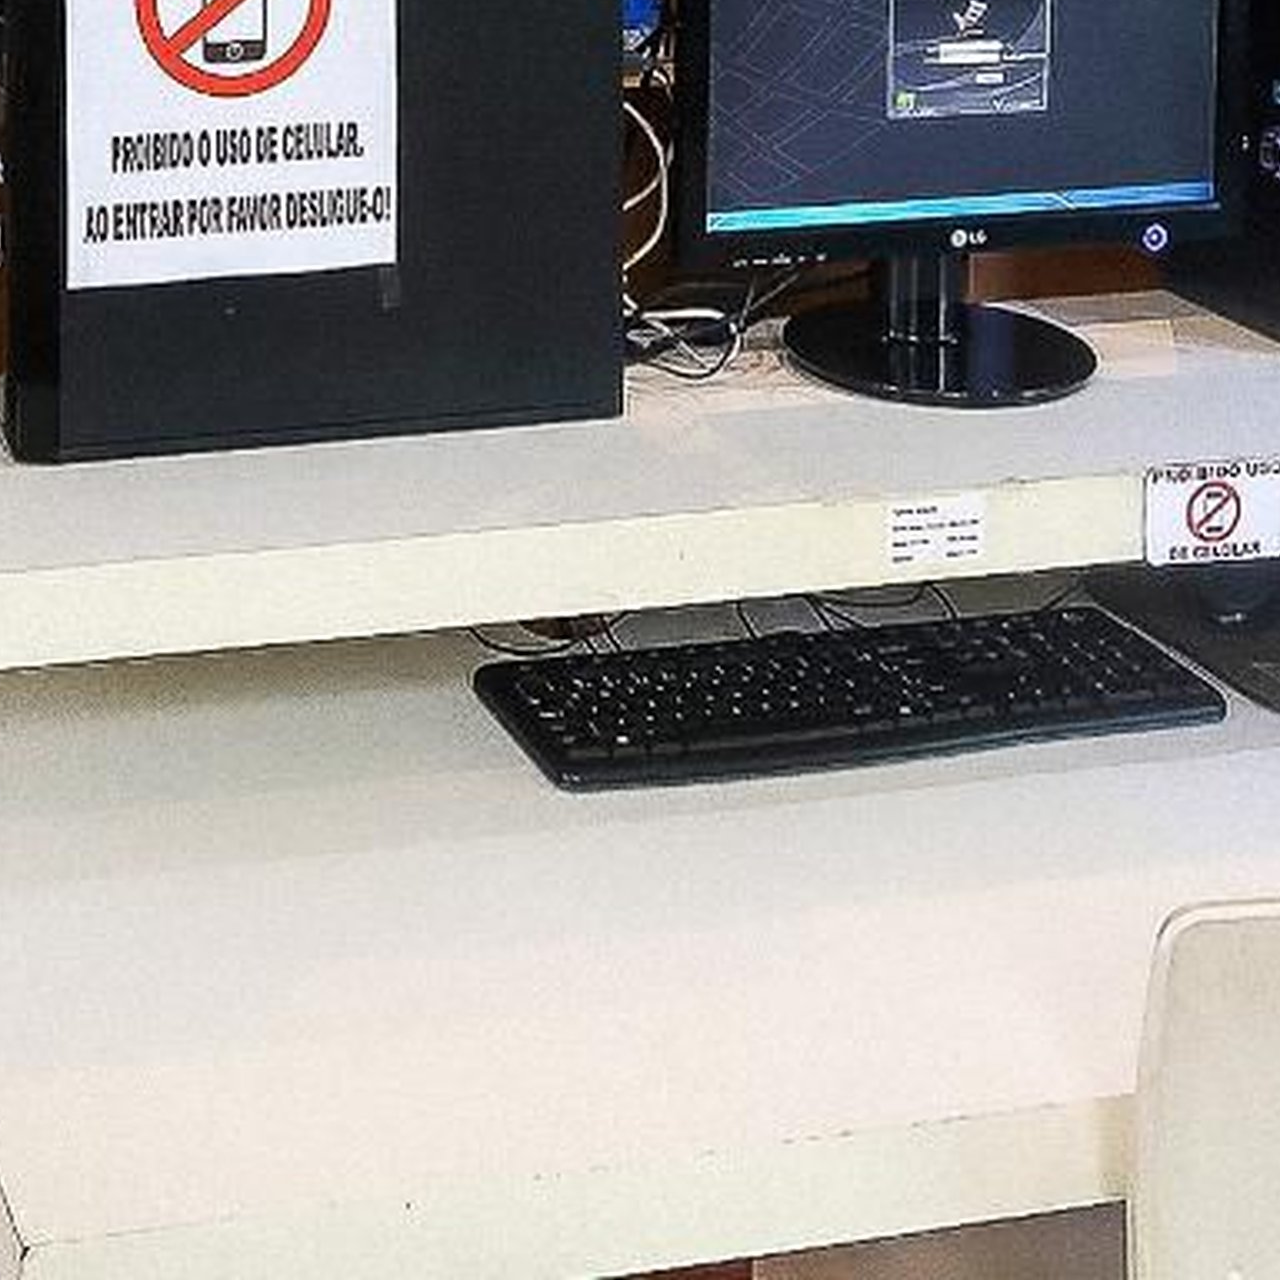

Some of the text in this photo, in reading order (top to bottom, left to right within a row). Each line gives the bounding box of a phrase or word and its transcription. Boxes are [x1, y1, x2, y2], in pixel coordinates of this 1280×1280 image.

[112, 131, 194, 173] PROIBIDO
[198, 129, 211, 168] O
[215, 127, 252, 166] USO
[256, 126, 277, 163] DE
[83, 185, 392, 244] AO ENTRAR POR FAVOR DESLIGUE-O!
[1151, 462, 1241, 484] PROIBIDO
